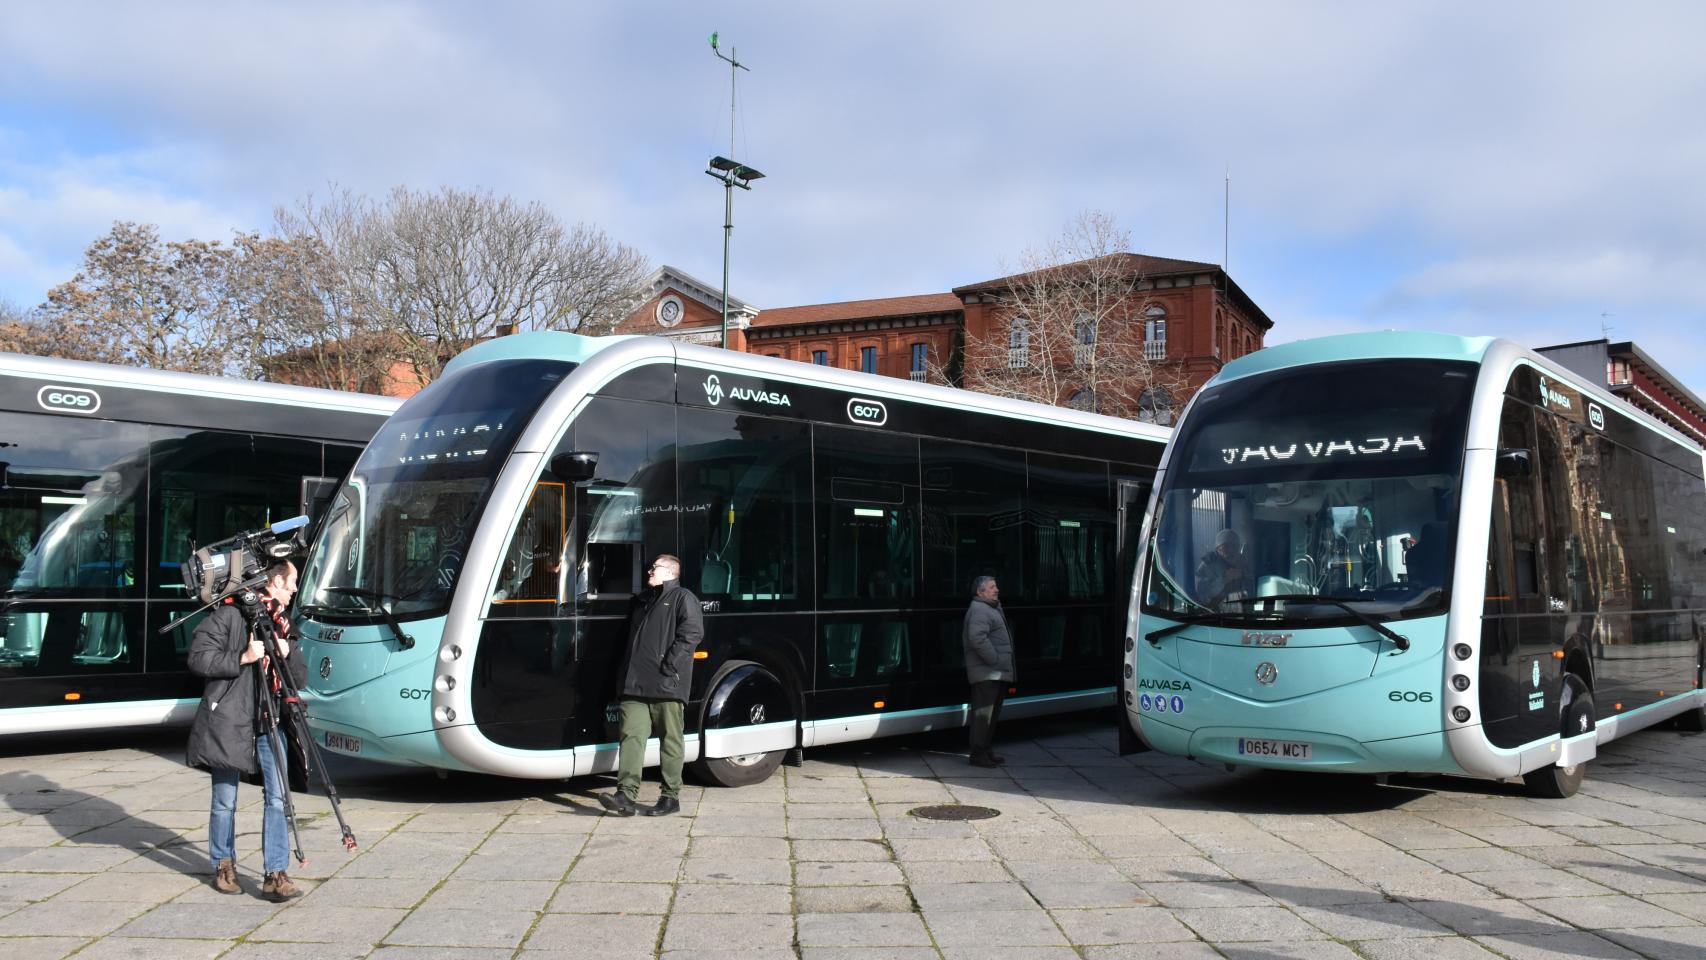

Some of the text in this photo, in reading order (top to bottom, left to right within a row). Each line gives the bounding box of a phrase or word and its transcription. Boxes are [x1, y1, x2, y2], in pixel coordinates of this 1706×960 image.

[48, 392, 90, 407] 609
[729, 387, 791, 407] AUVASA
[854, 405, 880, 419] 607
[1139, 678, 1192, 692] AUVASA
[400, 688, 431, 701] 607
[1388, 691, 1433, 703] 606
[1246, 740, 1308, 758] 0654 MCT
